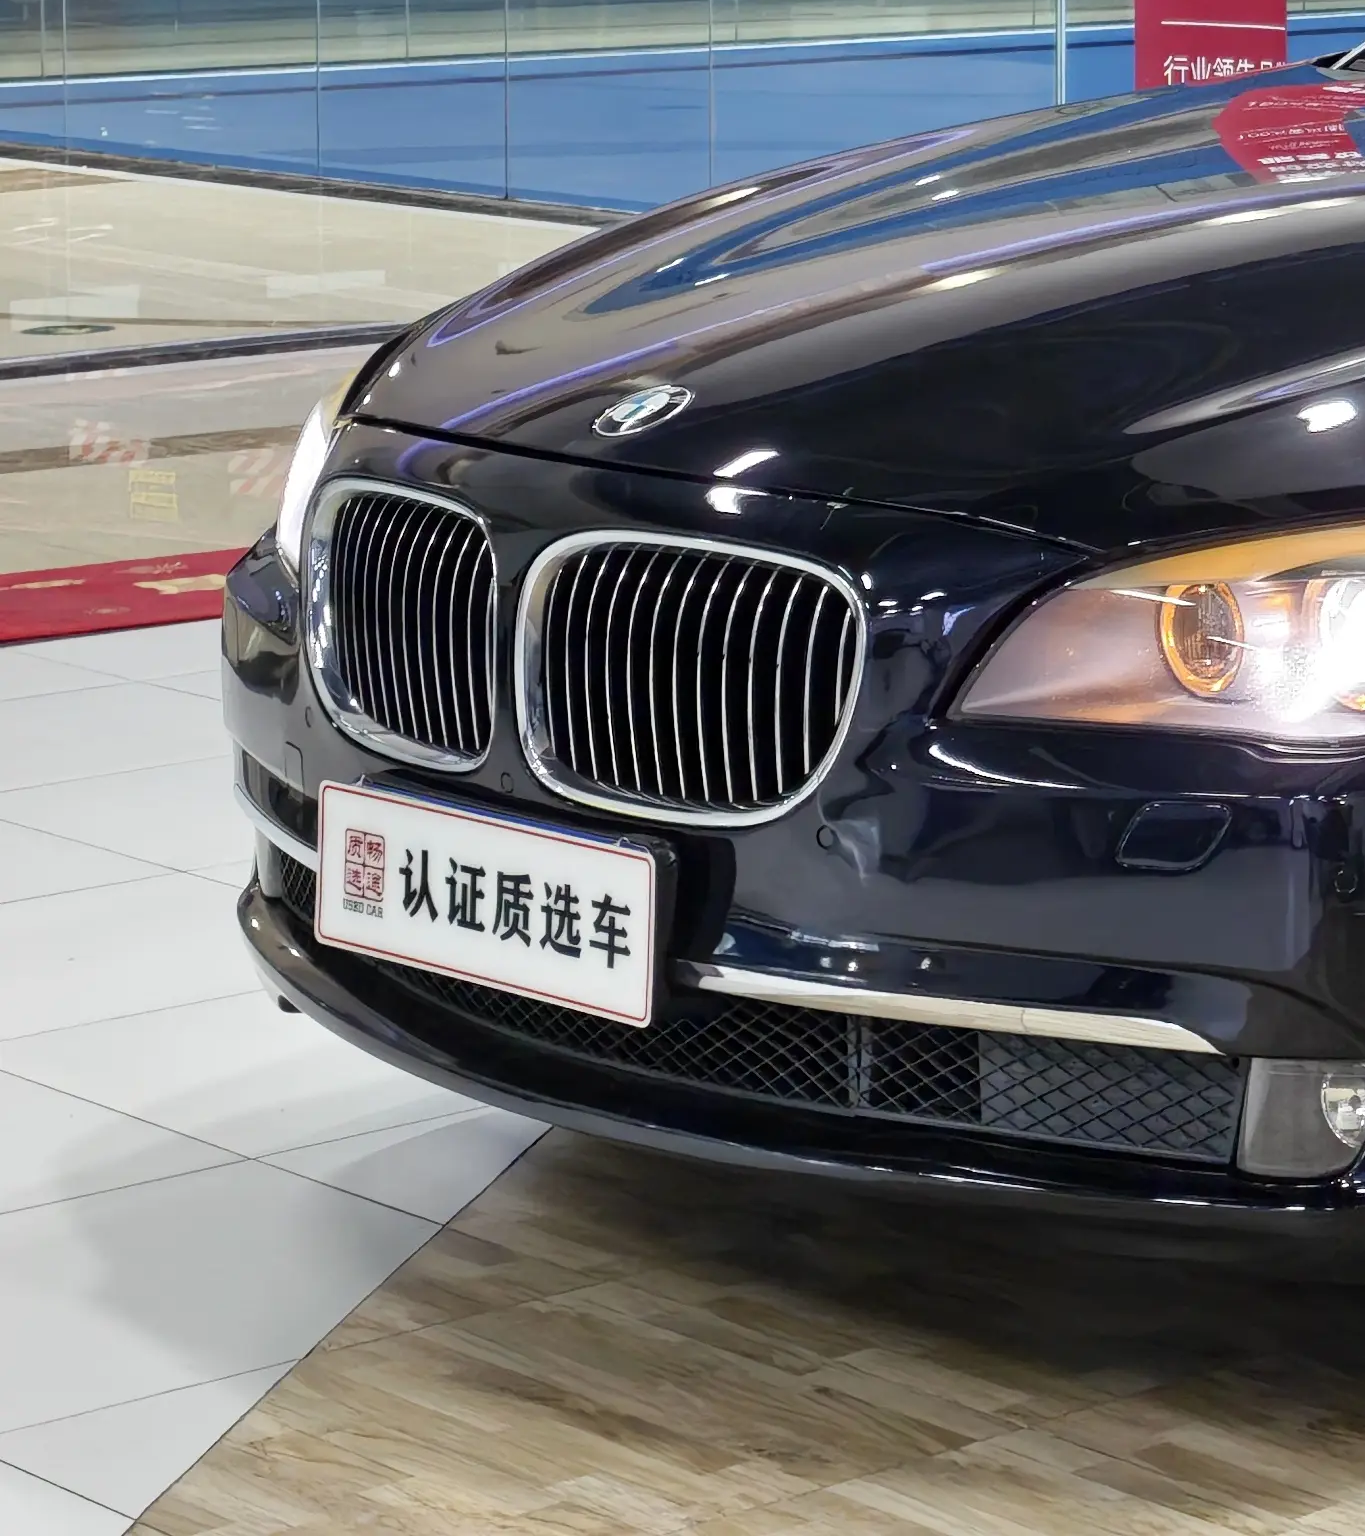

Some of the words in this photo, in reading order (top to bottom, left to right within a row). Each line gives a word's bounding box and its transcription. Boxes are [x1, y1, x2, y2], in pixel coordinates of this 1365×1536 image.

[399, 849, 631, 969] 认证质选车
